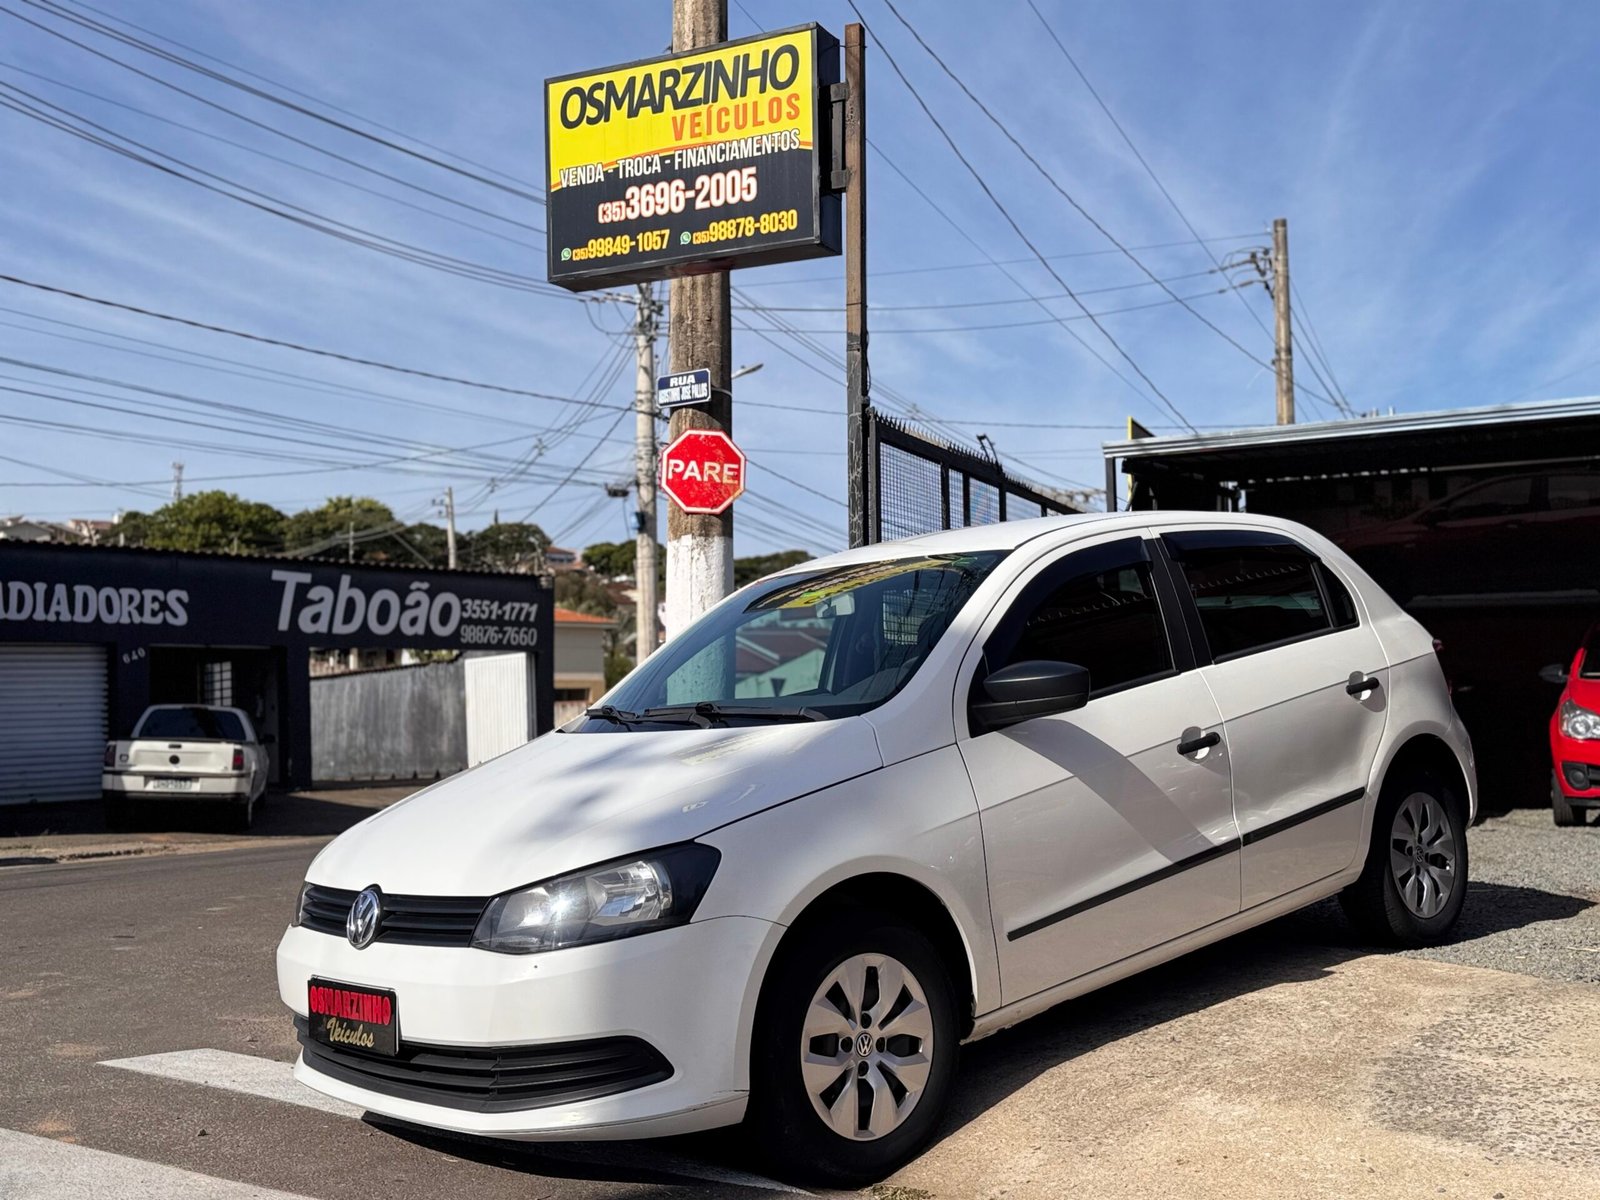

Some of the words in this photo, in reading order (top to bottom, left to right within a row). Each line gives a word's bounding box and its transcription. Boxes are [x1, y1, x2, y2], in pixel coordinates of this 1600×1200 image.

[560, 44, 800, 129] OSMARZINHO
[671, 93, 800, 141] VEÍCULOS
[559, 163, 605, 188] VENDA
[616, 153, 662, 180] TROCA
[674, 128, 800, 171] FINANCIAMENTOS
[670, 374, 696, 387] RUA
[668, 459, 739, 484] PARE
[271, 569, 461, 637] Taboão
[461, 598, 538, 622] 3551-1771
[460, 625, 538, 646] 98876-7660
[310, 985, 391, 1026] OSMARZINHO
